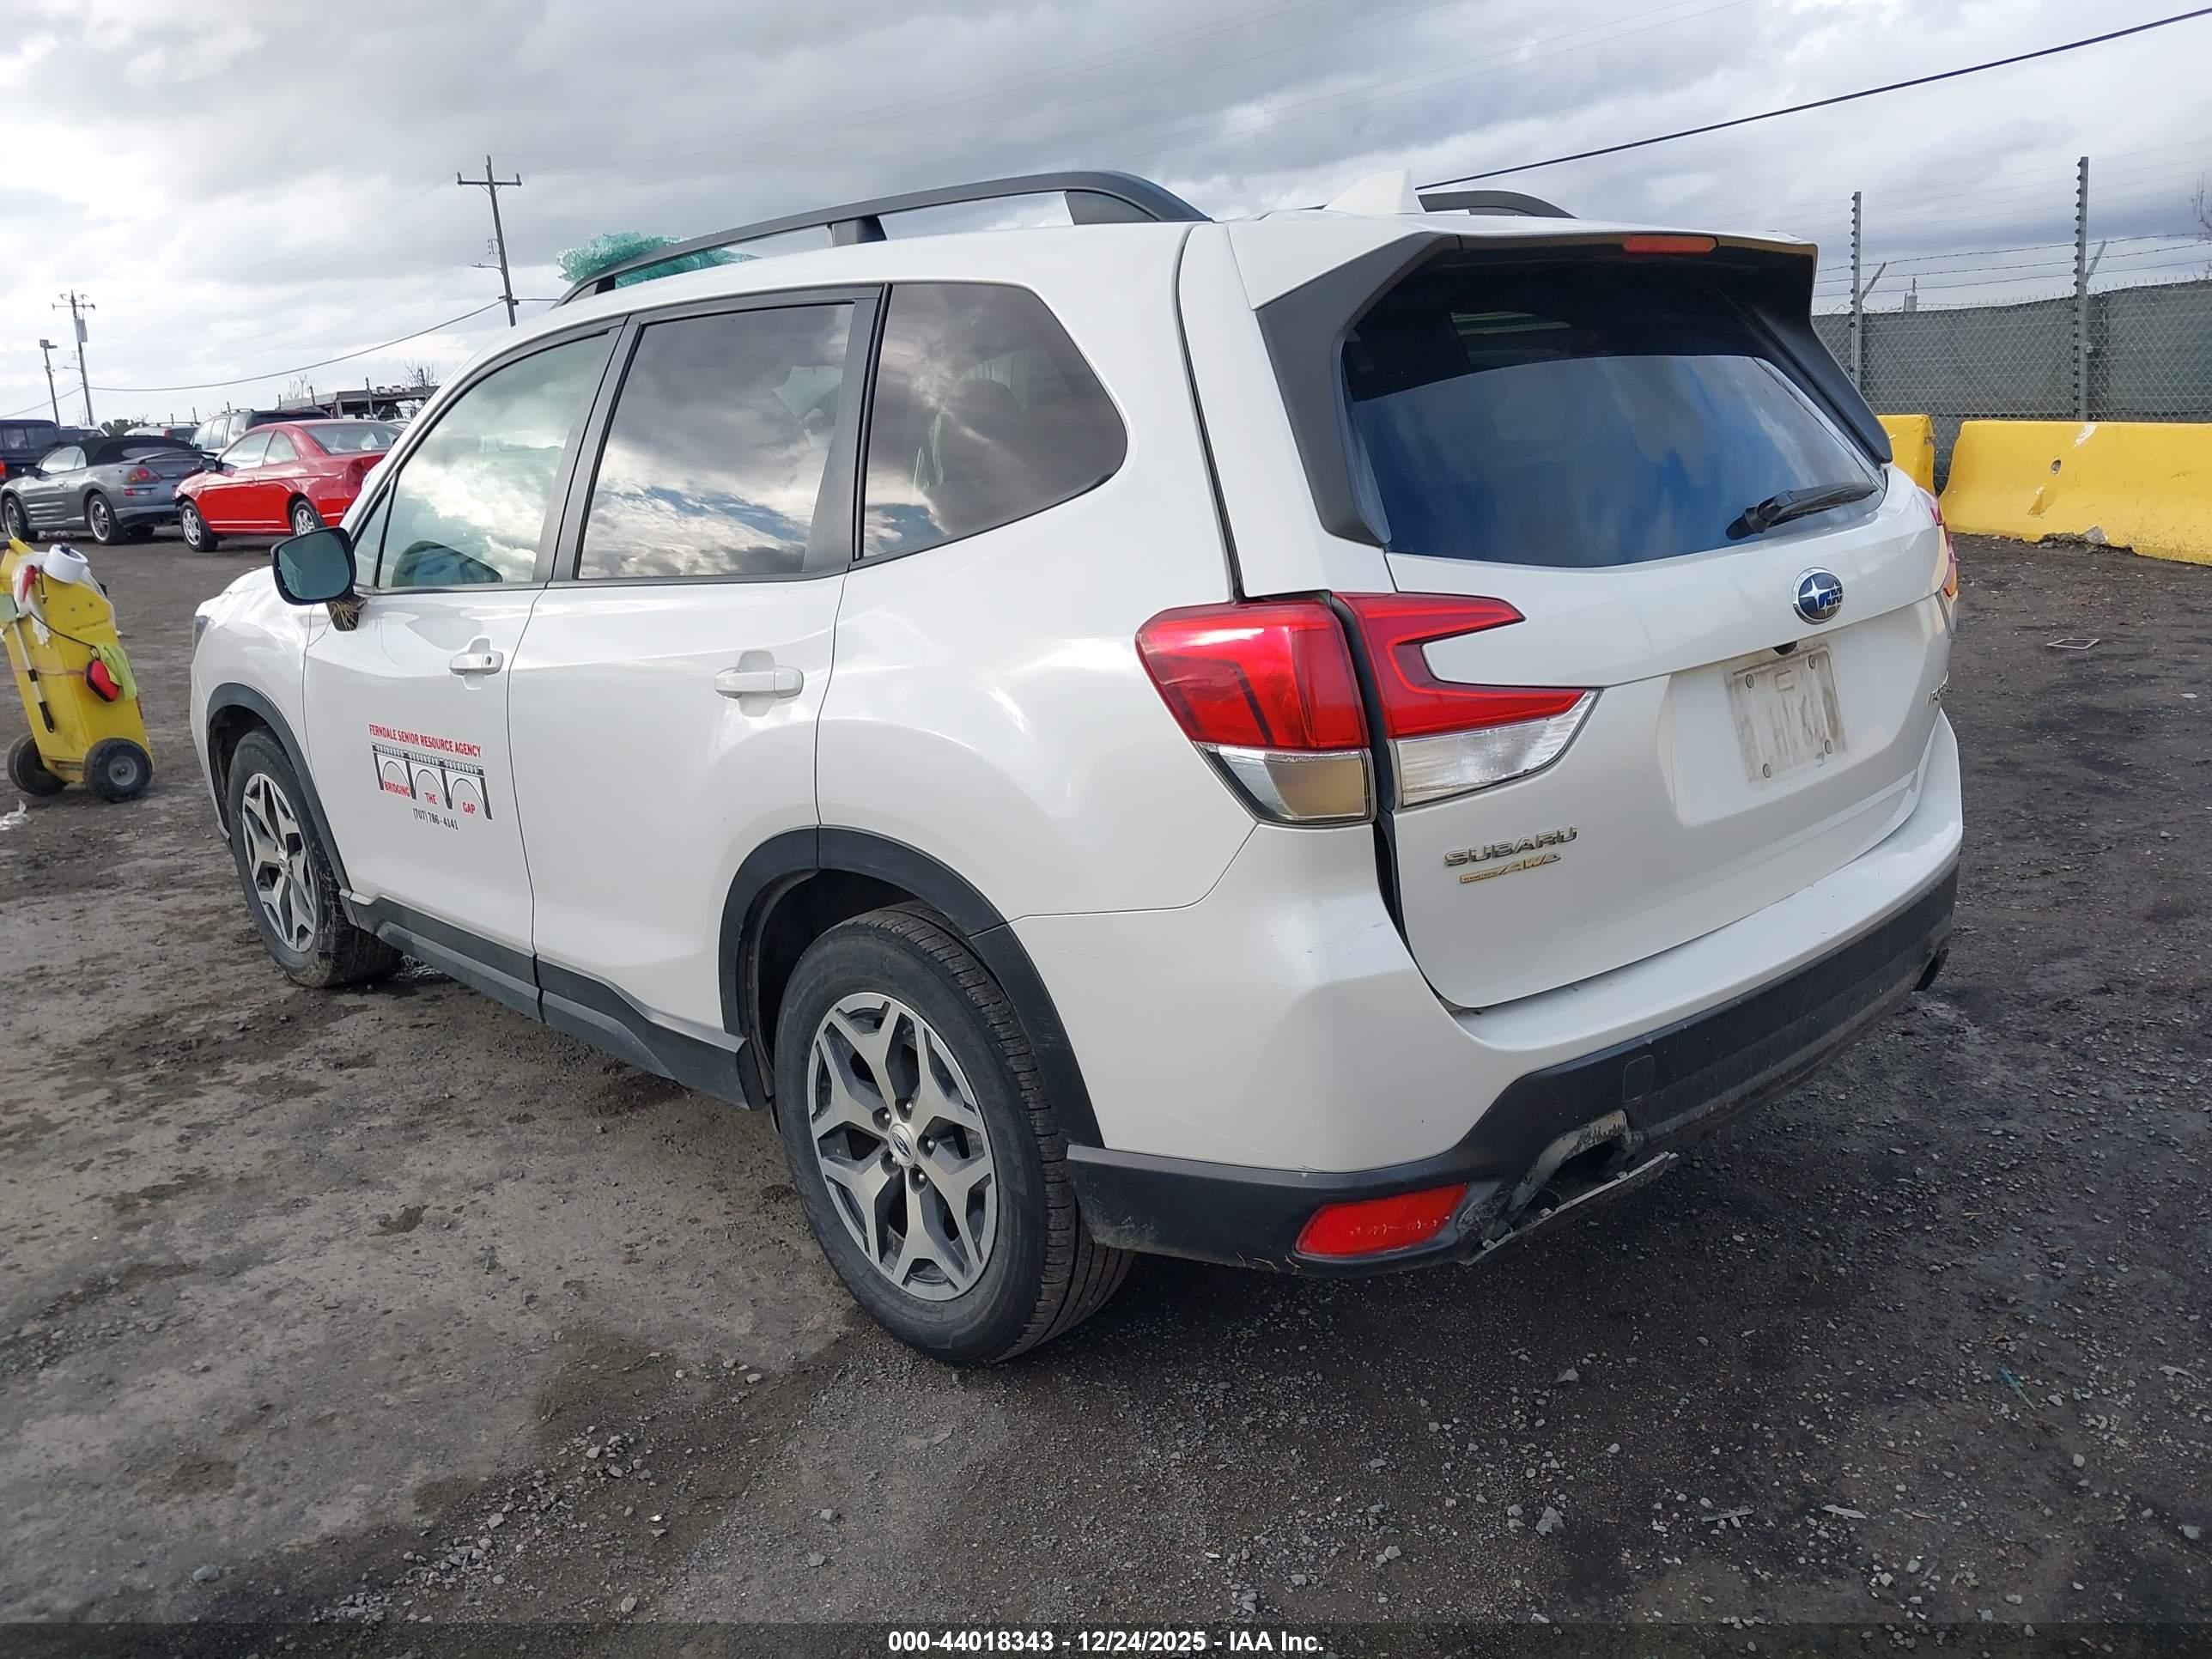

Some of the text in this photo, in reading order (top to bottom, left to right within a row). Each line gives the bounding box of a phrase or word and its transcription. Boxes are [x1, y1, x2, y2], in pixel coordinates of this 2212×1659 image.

[368, 723, 481, 758] FERNDALE SENIOR RESOURCE AGENCY
[384, 781, 476, 815] BRIDGING THE GAP
[412, 807, 428, 824] (707)
[1444, 824, 1578, 866] SUBARU
[1498, 852, 1561, 876] AWD
